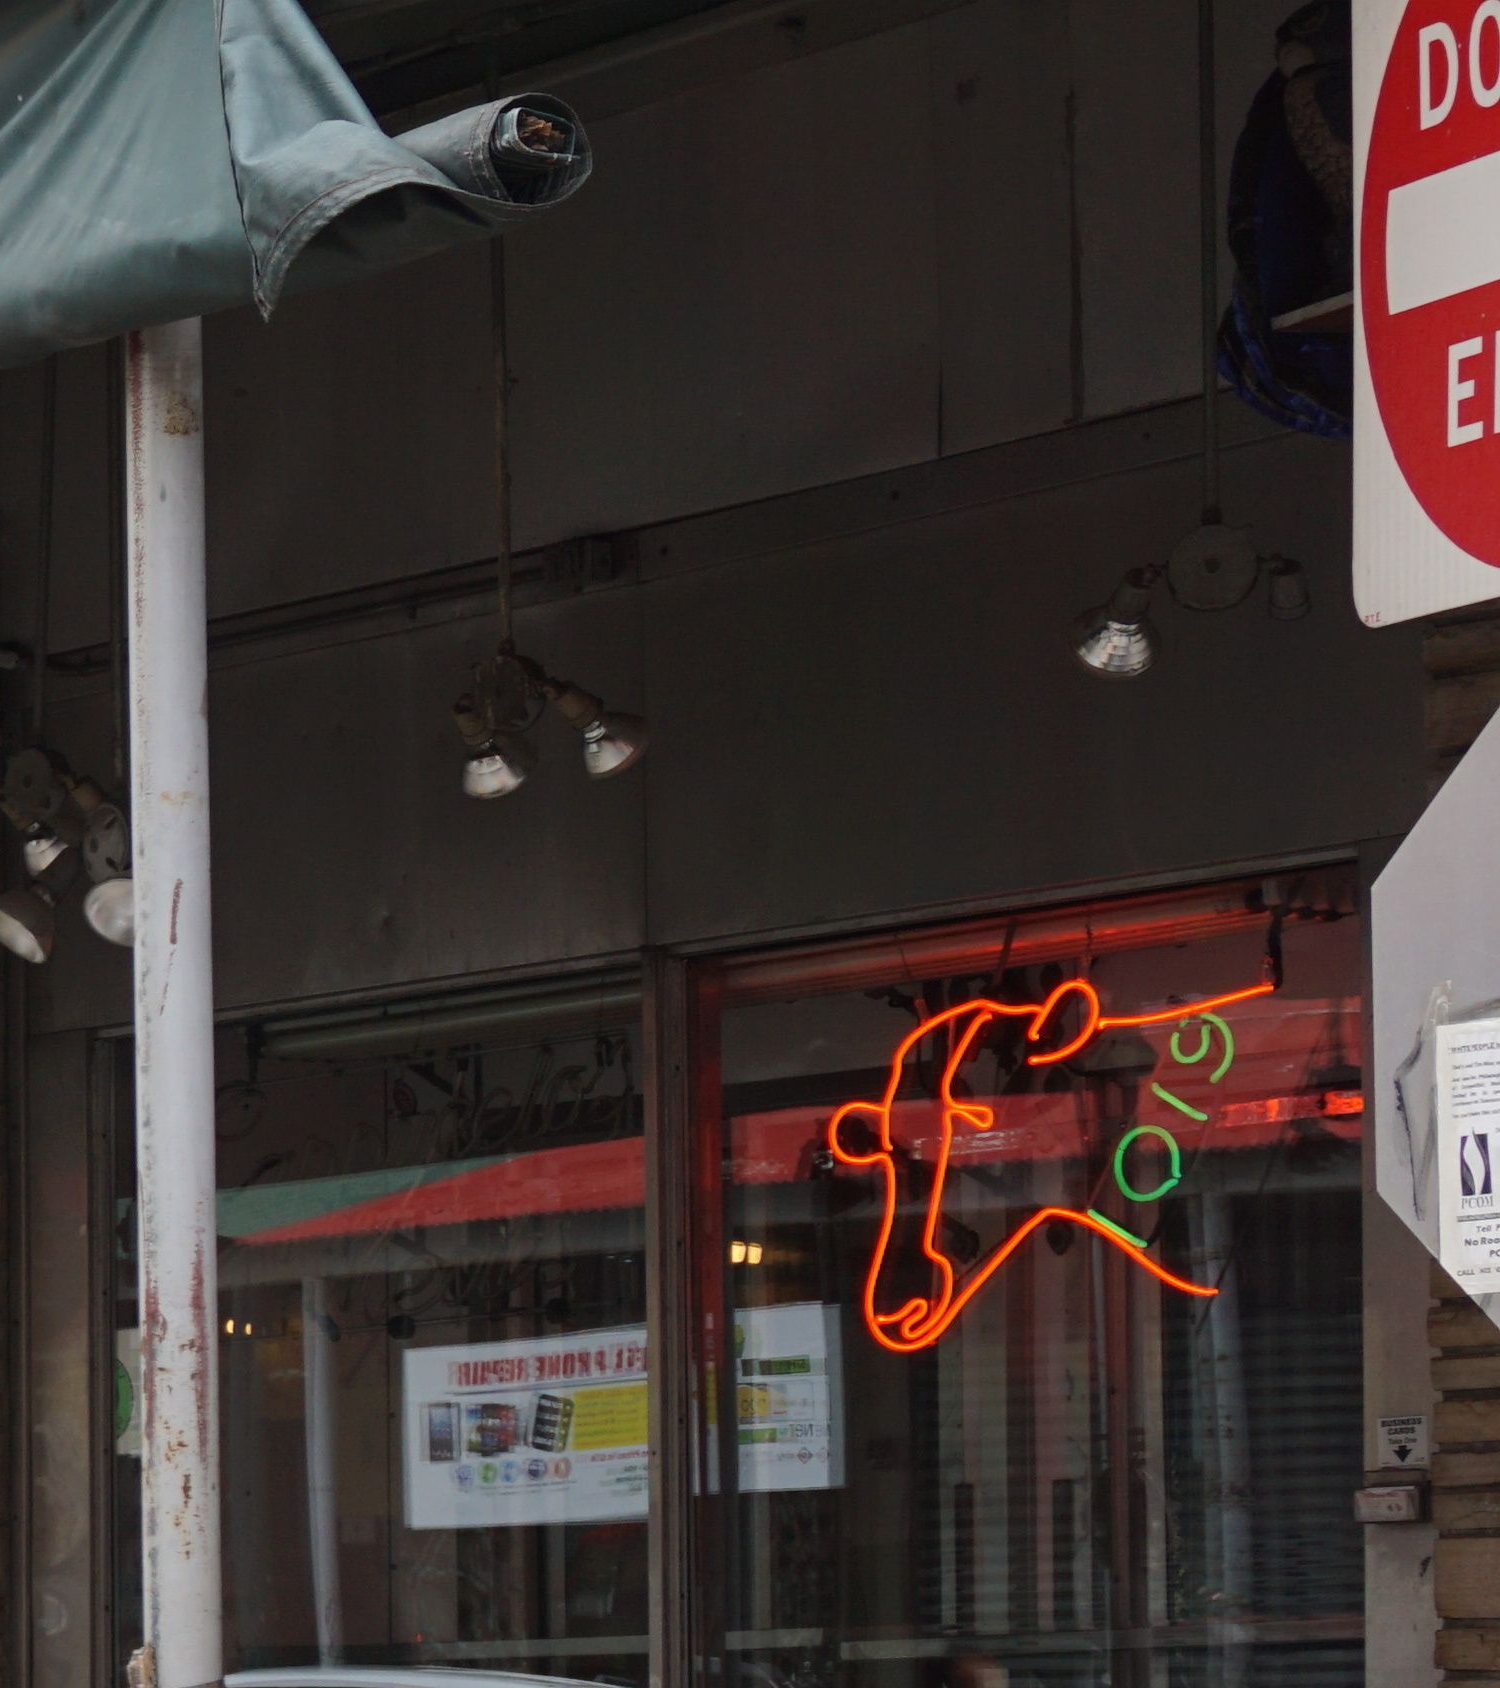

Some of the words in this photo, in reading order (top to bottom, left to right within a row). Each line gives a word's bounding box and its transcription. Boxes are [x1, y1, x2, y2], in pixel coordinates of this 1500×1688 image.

[1461, 1196, 1494, 1209] PCOM
[1480, 1237, 1500, 1245] Roo
[1381, 1418, 1422, 1427] BUSINESS
[1388, 1427, 1415, 1435] CARDS
